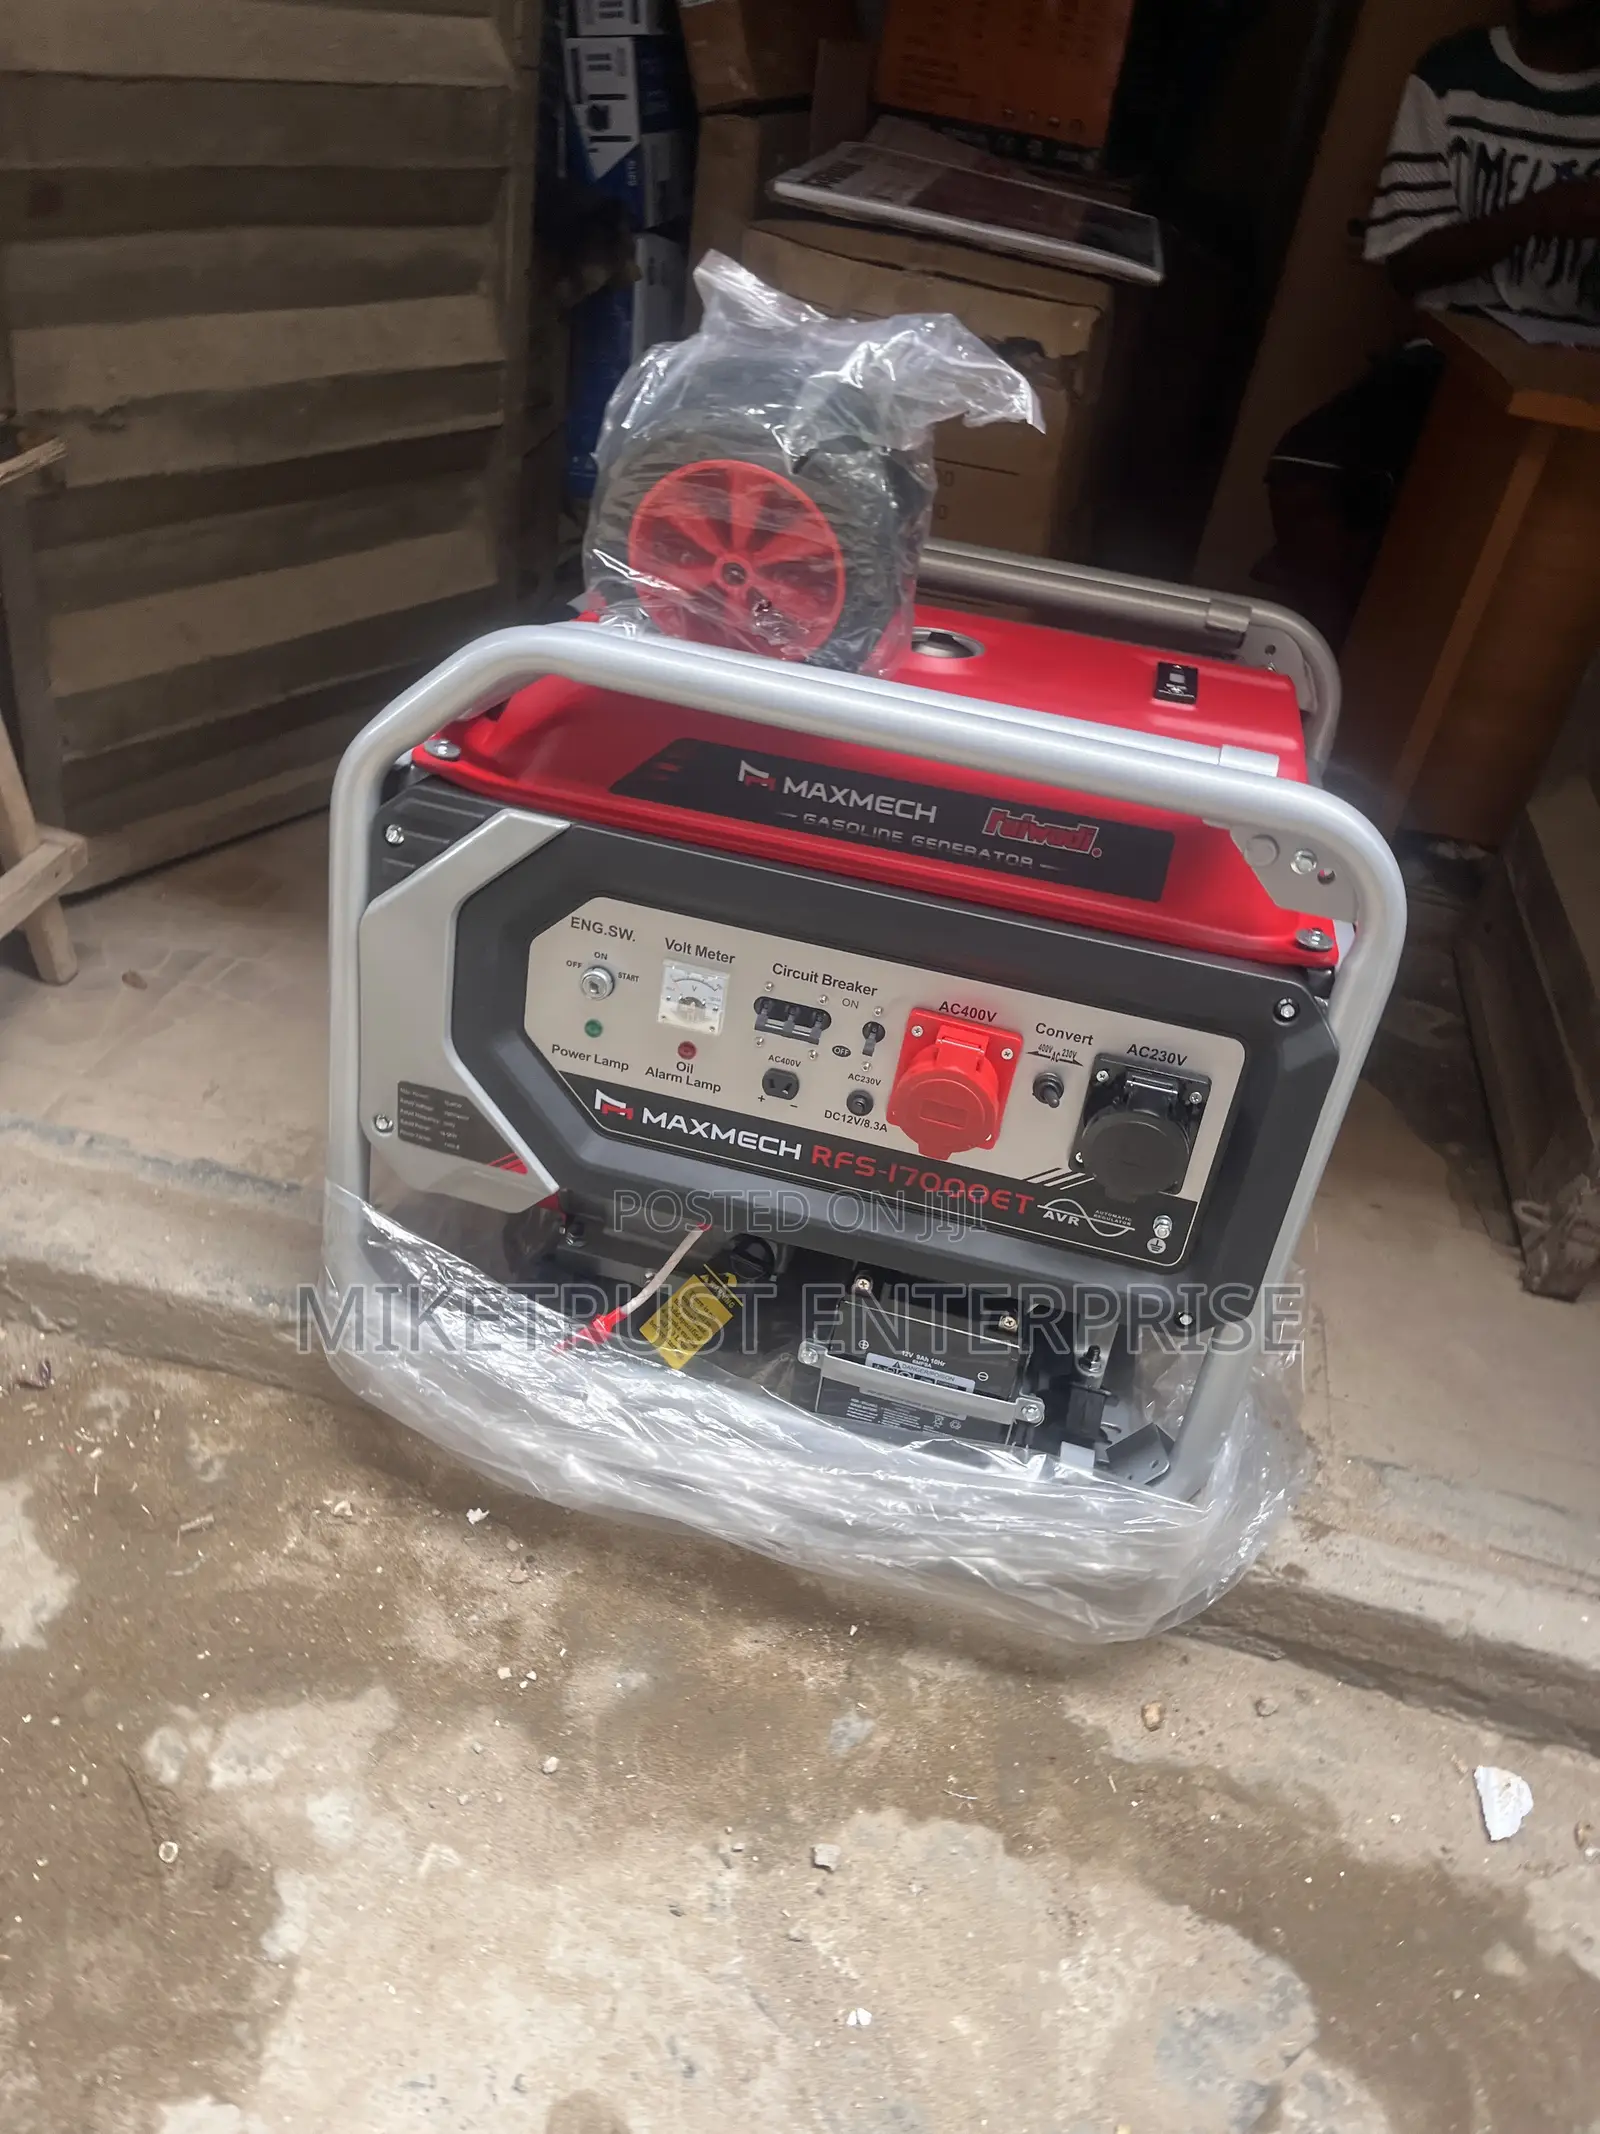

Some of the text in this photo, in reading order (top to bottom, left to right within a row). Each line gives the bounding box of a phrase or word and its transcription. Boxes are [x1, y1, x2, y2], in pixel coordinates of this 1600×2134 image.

[782, 776, 937, 823] MAXMECH
[803, 813, 1033, 869] GASOLINE GENERATOR
[570, 916, 636, 942] ENG.SW.
[594, 951, 608, 960] ON
[665, 937, 736, 964] Volt Meter
[566, 960, 582, 968] OFF
[618, 972, 639, 982] START
[772, 962, 878, 996] Circuit Breaker
[842, 998, 859, 1009] ON
[938, 1000, 998, 1023] AC400V
[1035, 1021, 1094, 1046] Convert
[551, 1043, 630, 1073] Power Lamp
[768, 1054, 802, 1068] AC400V
[834, 1046, 850, 1057] OFF
[1126, 1043, 1188, 1067] AC230V
[676, 1061, 694, 1075] Oil
[645, 1066, 722, 1094] Alarm Lamp
[848, 1073, 882, 1087] AC230V
[824, 1109, 888, 1133] DC12V/8.3A
[642, 1107, 1035, 1214] MAXMECH RFS-17000ET
[1042, 1210, 1080, 1227] AVR
[1095, 1210, 1132, 1222] AUTOMATIC
